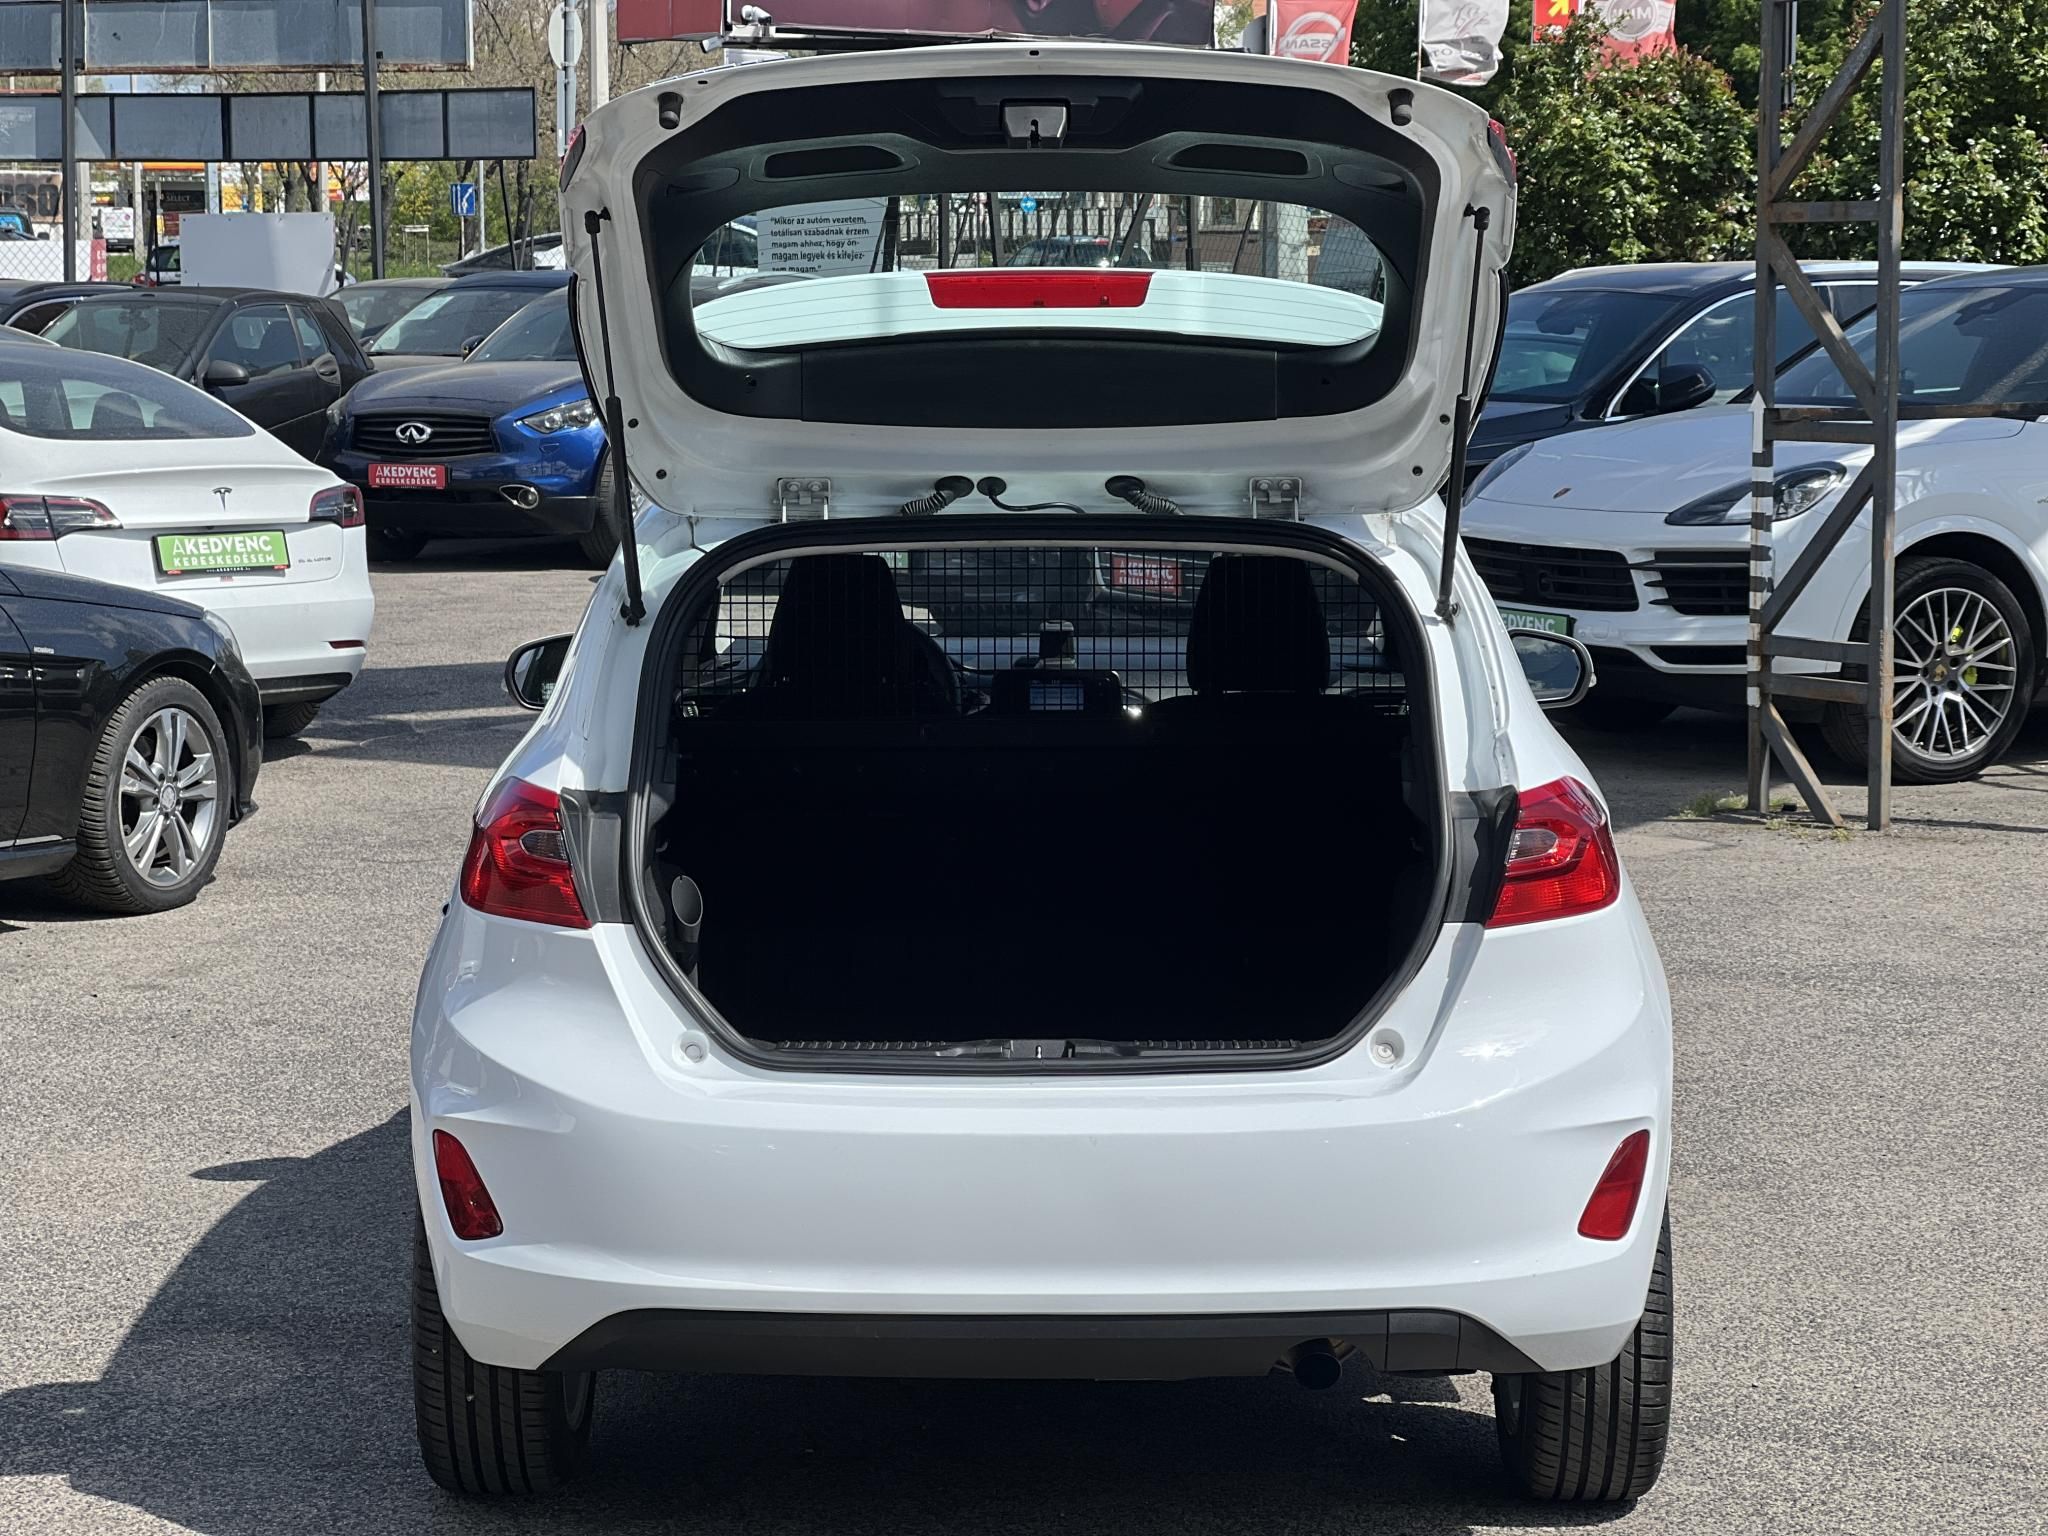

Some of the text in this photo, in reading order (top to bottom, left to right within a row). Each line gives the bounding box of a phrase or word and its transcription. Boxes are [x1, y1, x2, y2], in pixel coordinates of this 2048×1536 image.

[804, 227, 844, 236] szabadnak
[845, 226, 870, 235] érzem
[771, 241, 799, 249] magam
[826, 239, 846, 248] hogy
[771, 252, 799, 262] magam
[800, 250, 826, 262] legyek
[375, 465, 437, 478] AKEDVENC
[172, 535, 273, 556] AKEDVENC
[173, 550, 275, 567] KERESKEDÉSEM
[1500, 613, 1556, 633] EDVENC
